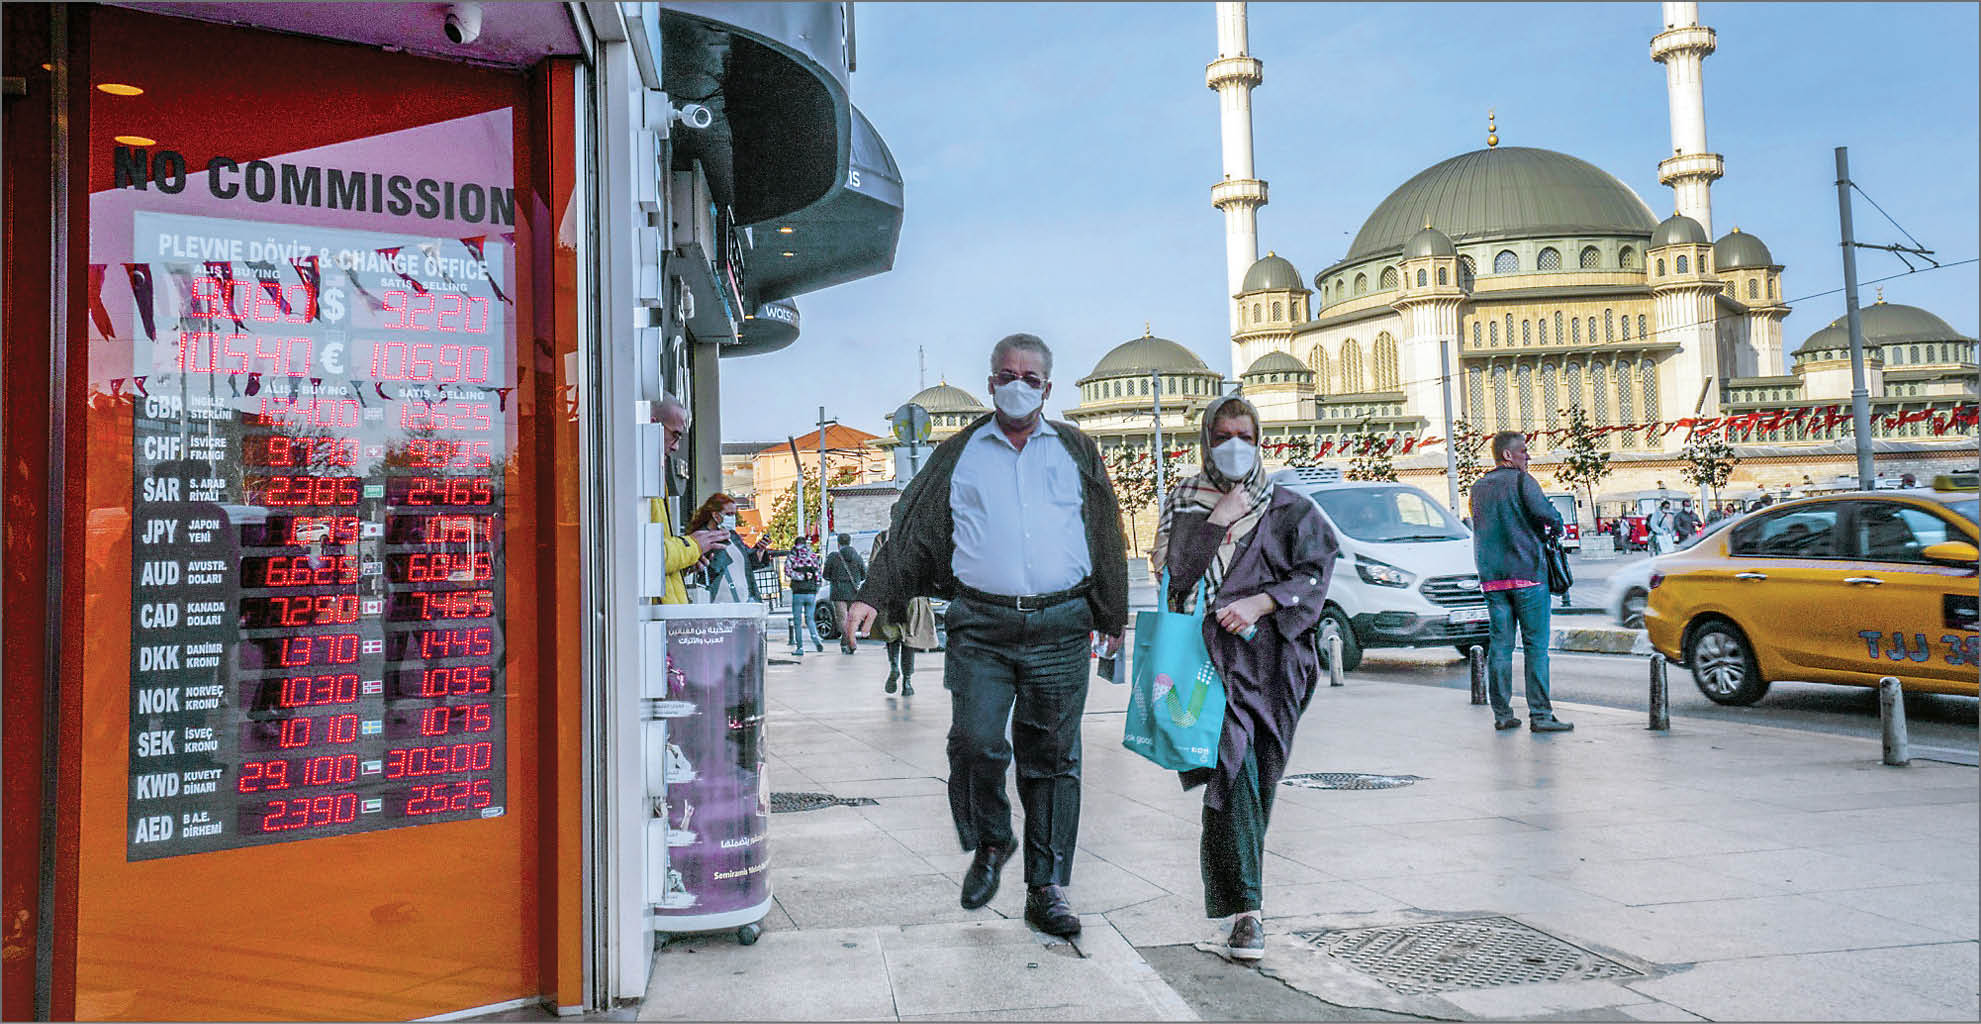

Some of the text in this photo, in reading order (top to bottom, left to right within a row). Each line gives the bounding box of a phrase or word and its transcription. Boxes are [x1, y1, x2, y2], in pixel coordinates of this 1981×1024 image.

[115, 147, 514, 225] NO COMMISSION
[160, 233, 488, 280] PLEVNE DÖVİZ & CHANGE OFFICE
[234, 269, 280, 279] BUYING
[423, 280, 467, 291] SELLING
[322, 287, 345, 324] $
[320, 342, 344, 374] €
[303, 386, 348, 395] BUYING
[440, 389, 485, 401] SELLING
[144, 436, 181, 460] CHF
[143, 477, 180, 502] SAR
[200, 478, 226, 489] ARAB
[189, 488, 219, 502] RİYALİ
[188, 519, 220, 530] JAPON
[142, 519, 178, 544] JPY
[188, 561, 227, 571] AVUSTR.
[141, 561, 179, 586] AUD
[188, 573, 222, 584] DOLARI
[187, 602, 225, 613] KANADA
[141, 603, 178, 628] CAD
[187, 615, 221, 626] DOLARI
[1858, 630, 1929, 662] TJJ
[139, 645, 180, 671] DKK
[186, 656, 219, 668] KRONU
[185, 685, 224, 698] NORVEÇ
[138, 687, 180, 714] NOK
[185, 699, 219, 711] KRONU
[185, 727, 213, 740] İSVEÇ
[138, 730, 175, 757] SEK
[184, 741, 218, 753] KRONU
[184, 769, 223, 781] KUVEYT
[137, 772, 179, 800] KWD
[183, 782, 216, 795] DİNARI
[135, 815, 173, 844] AED
[183, 821, 222, 838] DİRHEMİ
